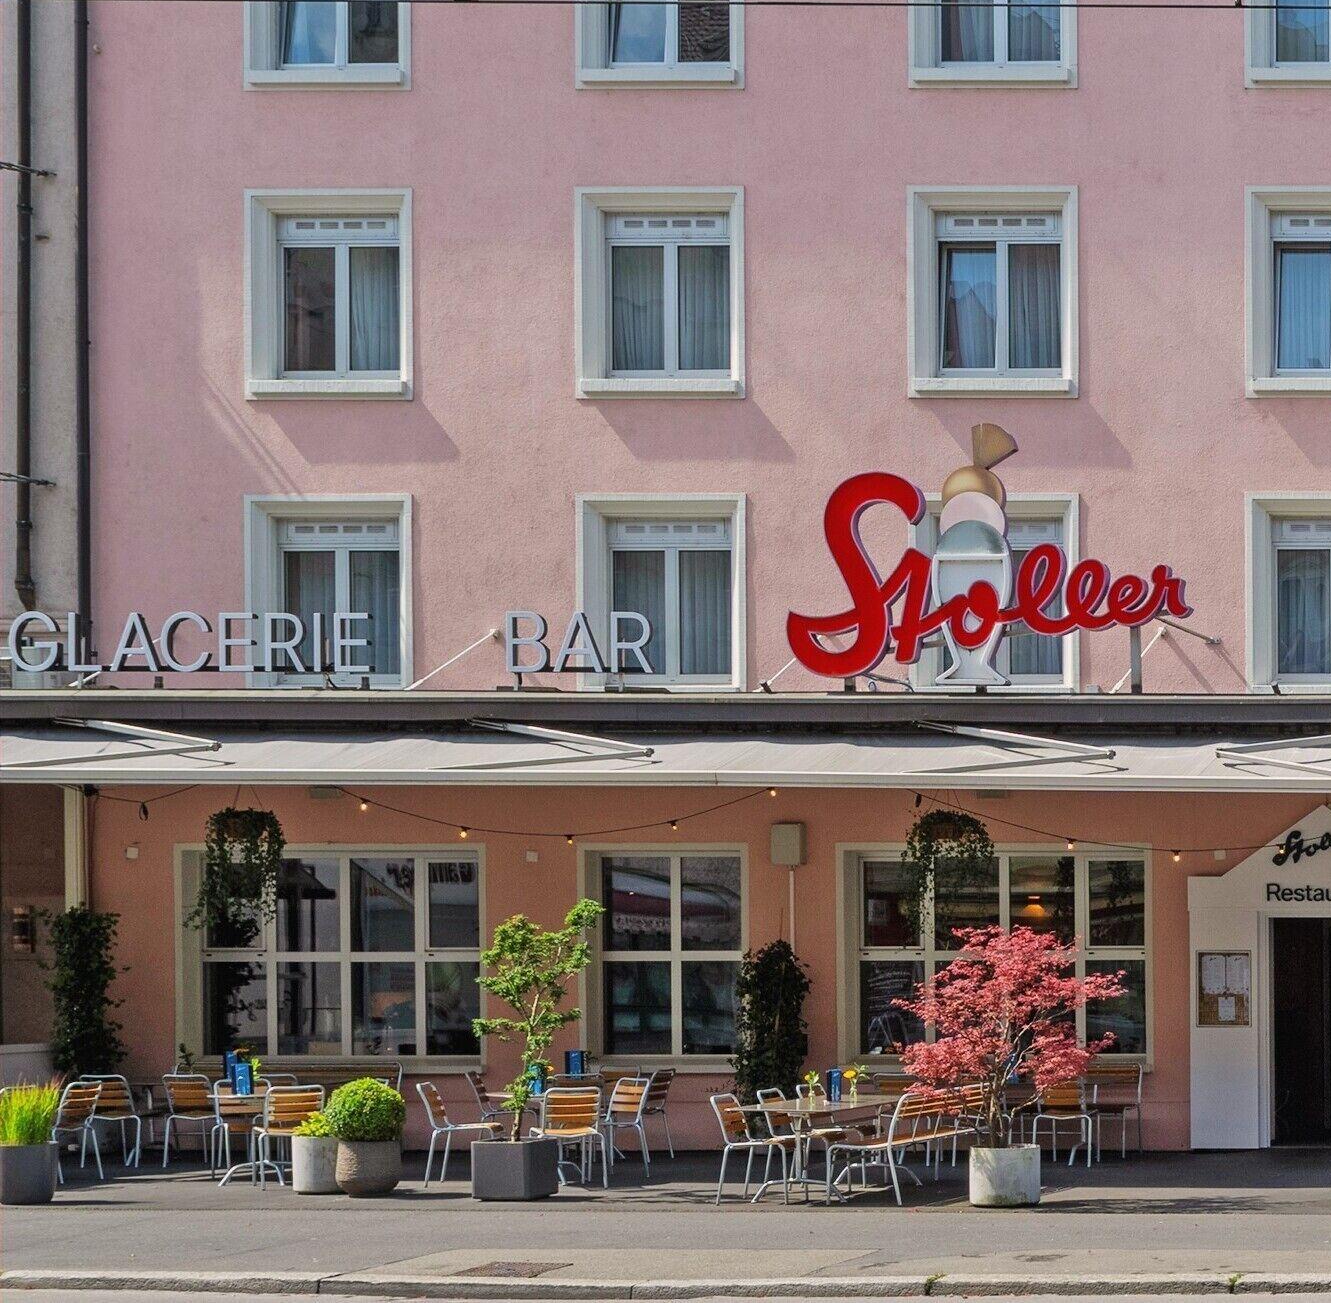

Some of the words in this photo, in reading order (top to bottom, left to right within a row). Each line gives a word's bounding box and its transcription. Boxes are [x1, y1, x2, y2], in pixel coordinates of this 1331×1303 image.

[786, 471, 1194, 678] Stoller
[8, 610, 373, 673] GLACERIE
[504, 610, 655, 674] BAR
